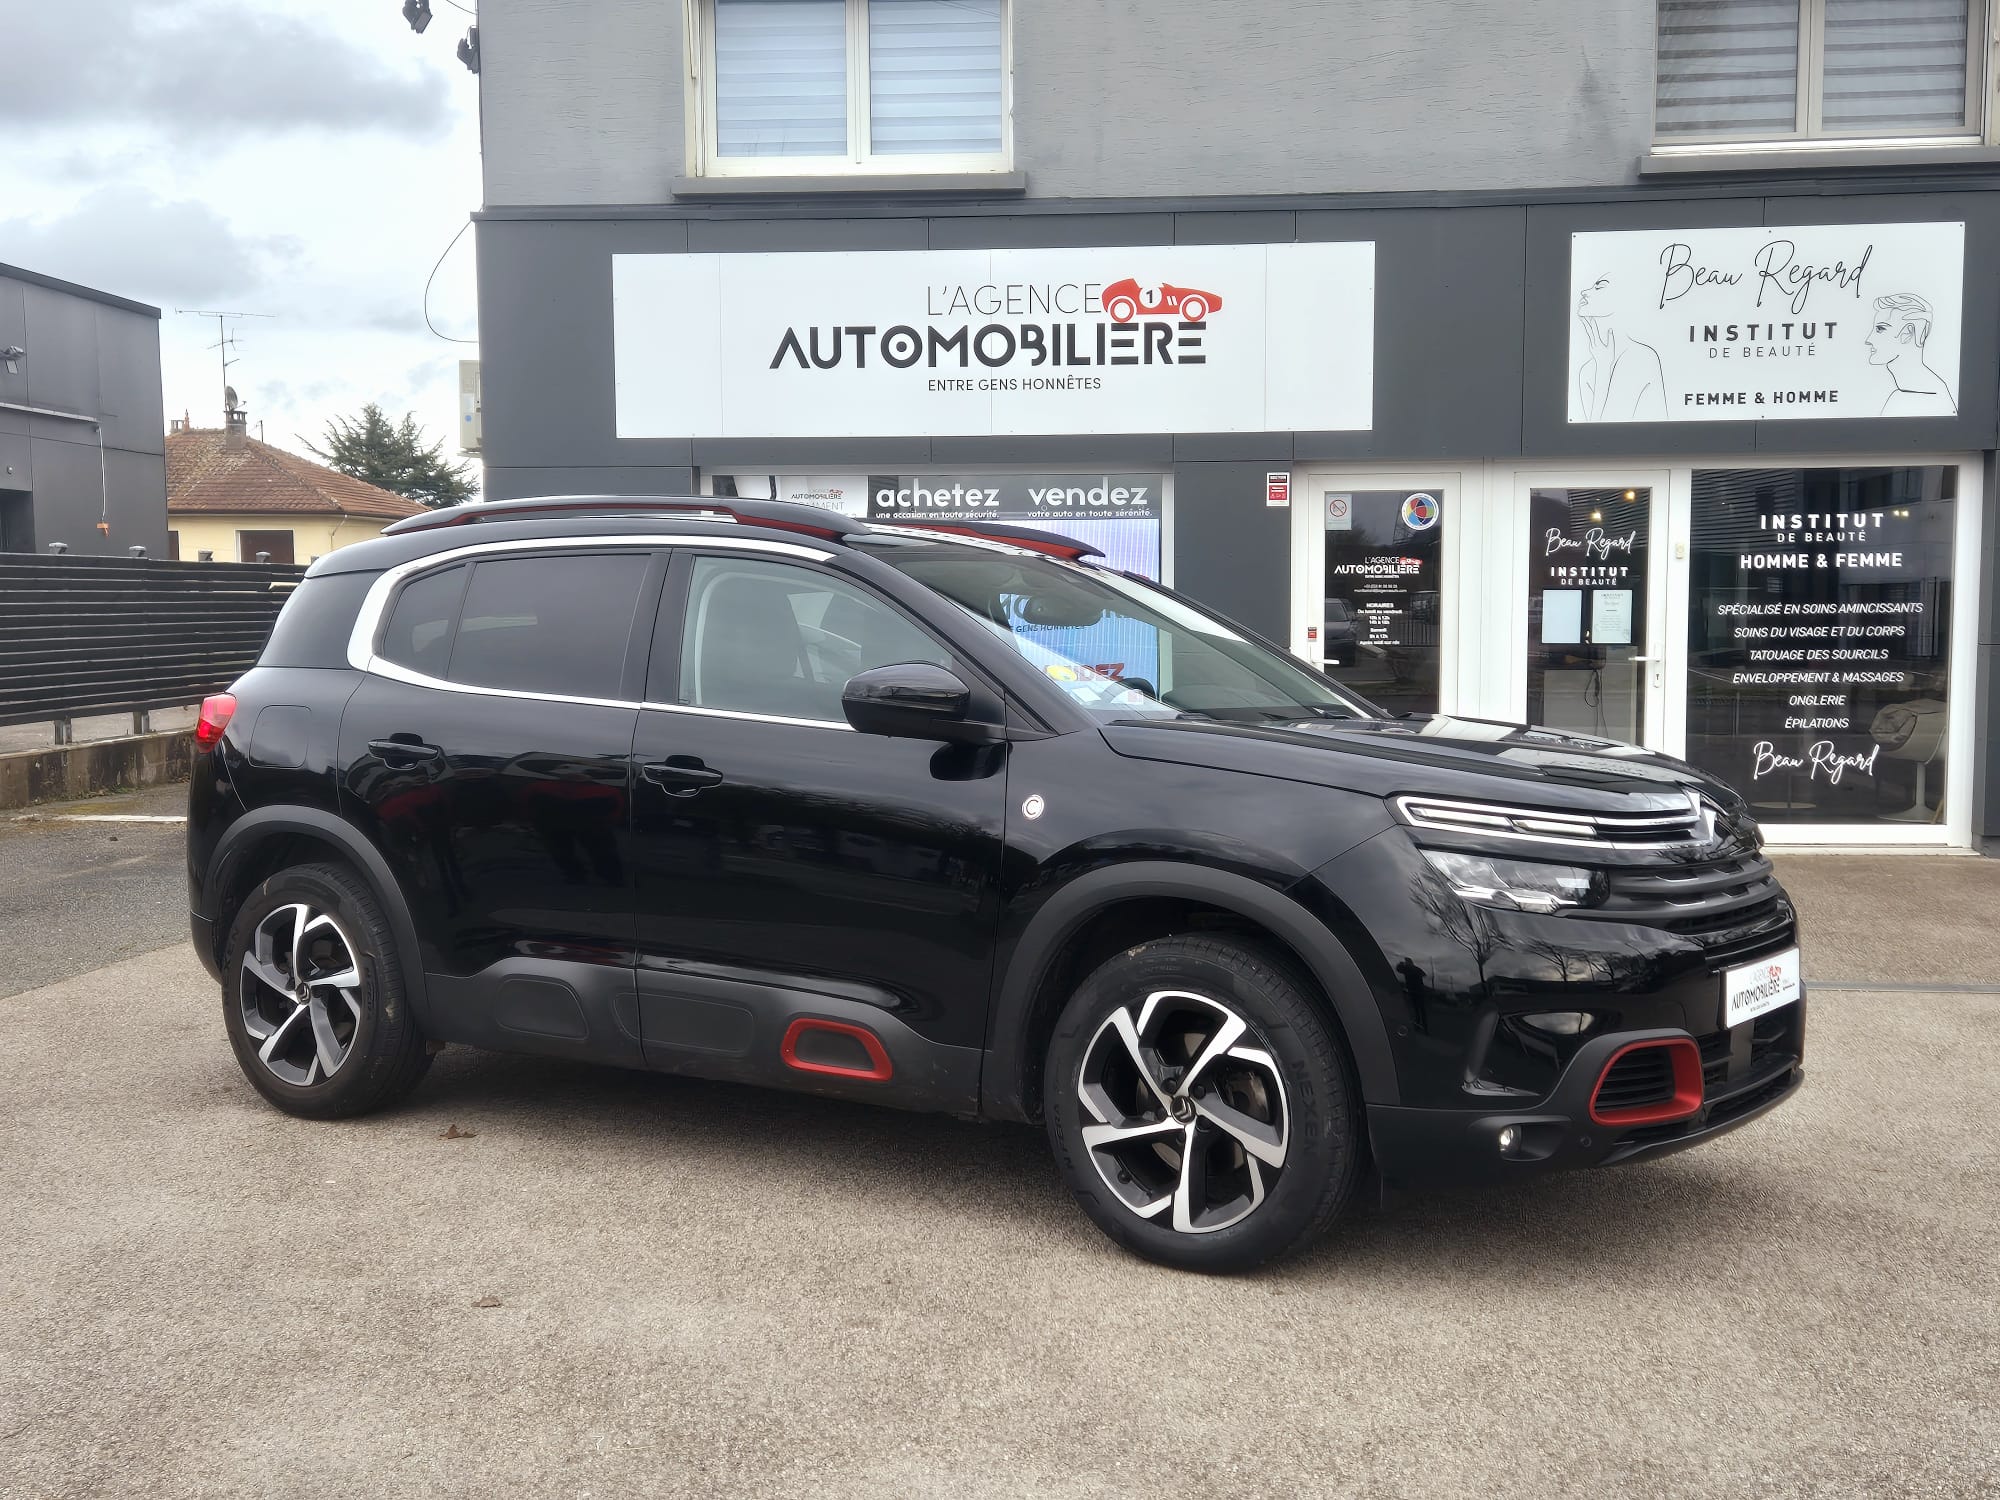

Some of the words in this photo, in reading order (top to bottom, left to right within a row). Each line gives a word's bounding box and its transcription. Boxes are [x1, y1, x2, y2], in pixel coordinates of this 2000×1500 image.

[1660, 244, 1742, 309] Beau
[1755, 240, 1872, 314] Regard
[928, 284, 1101, 315] L'AGENCE
[1690, 322, 1837, 344] INSTITUT
[1710, 348, 1730, 358] DE
[1744, 343, 1814, 357] BEAUTÉ
[929, 380, 972, 391] ENTRE
[979, 379, 1017, 390] GENS
[1023, 375, 1100, 389] HONNÊTES
[1685, 393, 1746, 405] FEMME
[1755, 392, 1764, 403] &
[1774, 391, 1838, 403] HOMME
[876, 478, 1000, 508] achetez
[1028, 476, 1148, 506] vendez
[893, 510, 926, 518] occasion
[1760, 512, 1884, 530] INSTITUT
[1776, 532, 1796, 542] DE
[1804, 530, 1866, 542] BEAUTÉ
[1545, 527, 1582, 557] Beau
[1585, 528, 1636, 561] Regard
[1740, 554, 1809, 570] HOMME
[1816, 554, 1828, 568] &
[1836, 552, 1903, 568] FEMME
[1551, 567, 1628, 576] INSTITUT
[1579, 577, 1616, 585] BEAUTÉ
[1717, 602, 1782, 616] SPÉCIALISÉ
[1784, 604, 1800, 614] EN
[1802, 603, 1837, 614] SOINS
[1838, 602, 1924, 614] AMINCISSANTS
[1734, 627, 1768, 638] SOINS
[1770, 627, 1787, 638] DU
[1790, 626, 1829, 637] VISAGE
[1830, 626, 1846, 636] ET
[1848, 626, 1864, 636] DU
[1866, 626, 1906, 636] CORPS
[1750, 650, 1804, 660] TATOUAGE
[1807, 650, 1830, 660] DES
[1832, 648, 1889, 660] SOURCILS
[1732, 672, 1830, 684] ENVELOPPEMENT
[1832, 672, 1840, 683] &
[1842, 672, 1904, 682] MASSAGES
[1789, 695, 1846, 706] ONGLERIE
[1784, 716, 1850, 729] ÉPILATIONS
[1752, 740, 1804, 780] Beau
[1808, 740, 1880, 784] Regard
